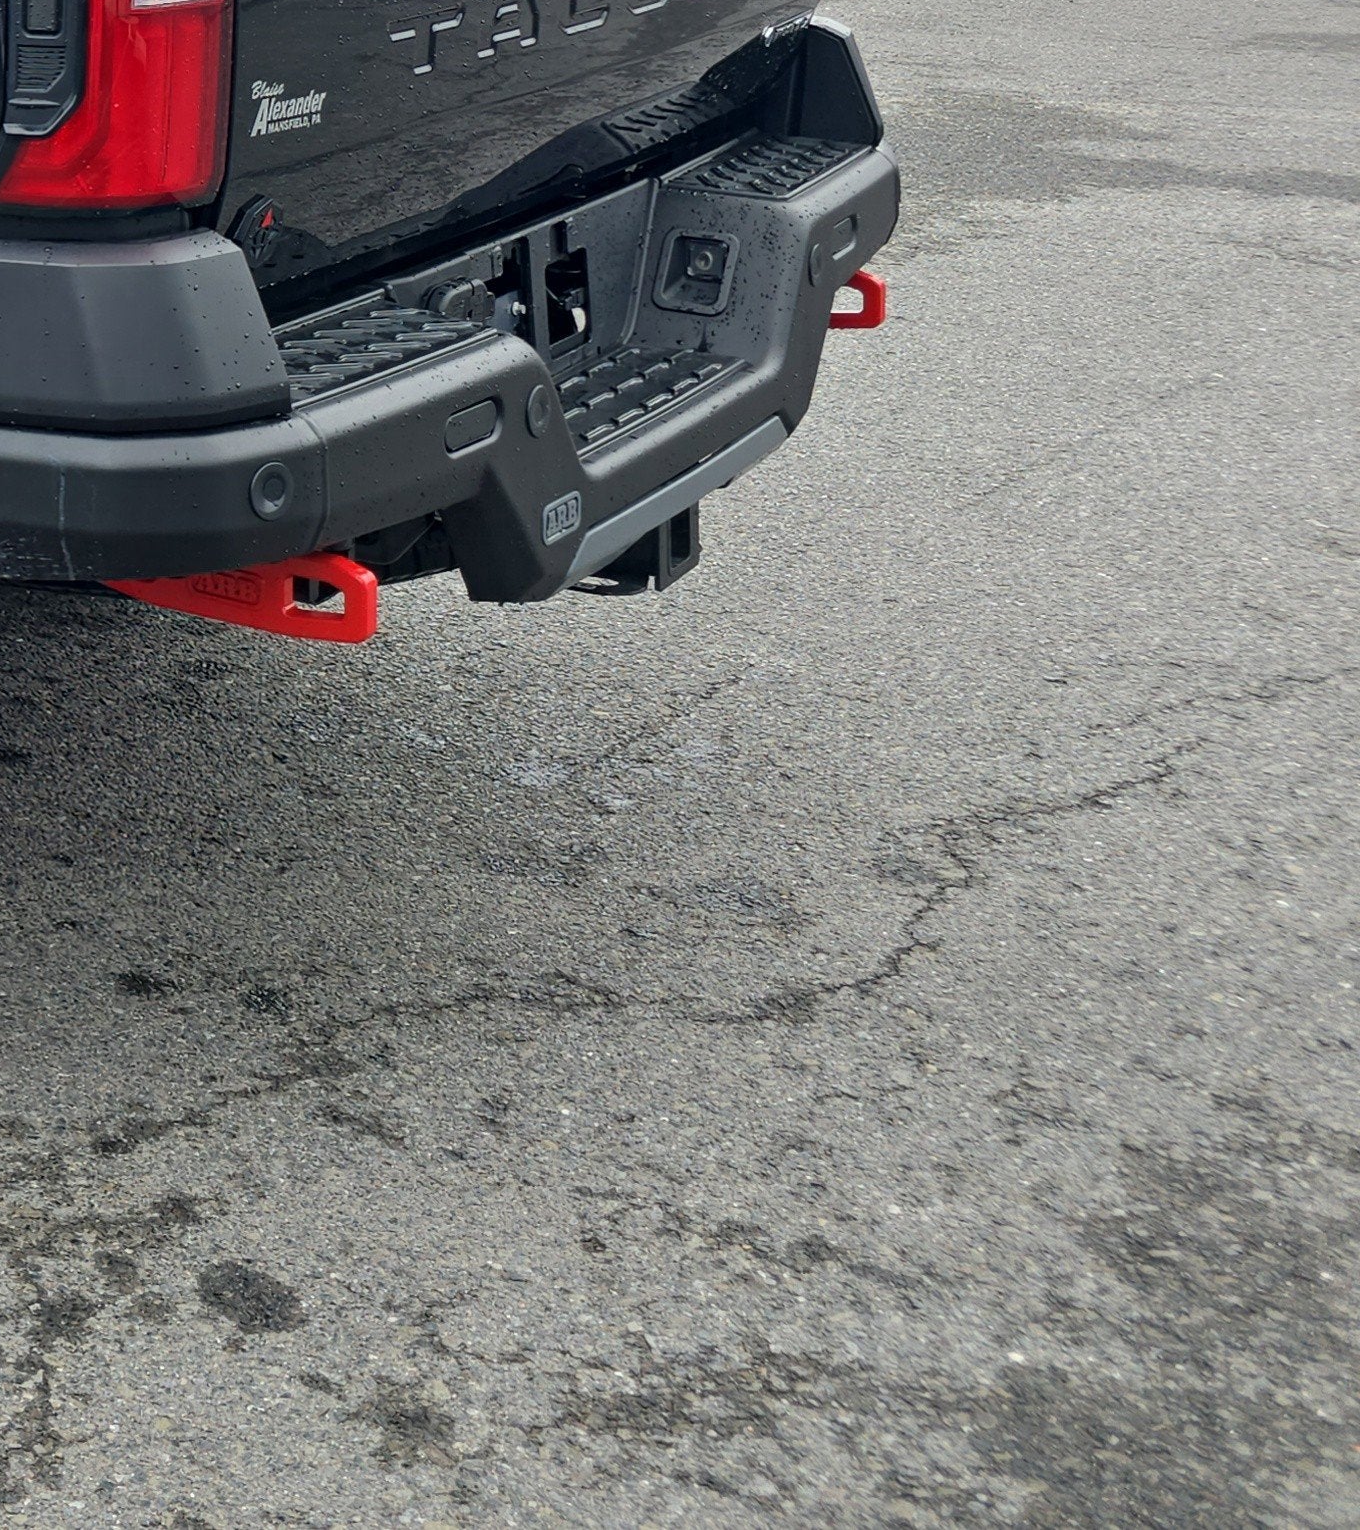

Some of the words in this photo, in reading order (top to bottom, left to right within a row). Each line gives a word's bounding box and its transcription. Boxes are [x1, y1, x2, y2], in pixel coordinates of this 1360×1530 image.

[251, 80, 285, 100] Blaise
[250, 89, 327, 137] Alexander
[311, 113, 322, 126] PA
[545, 498, 578, 538] ARB
[191, 570, 259, 602] ARB
